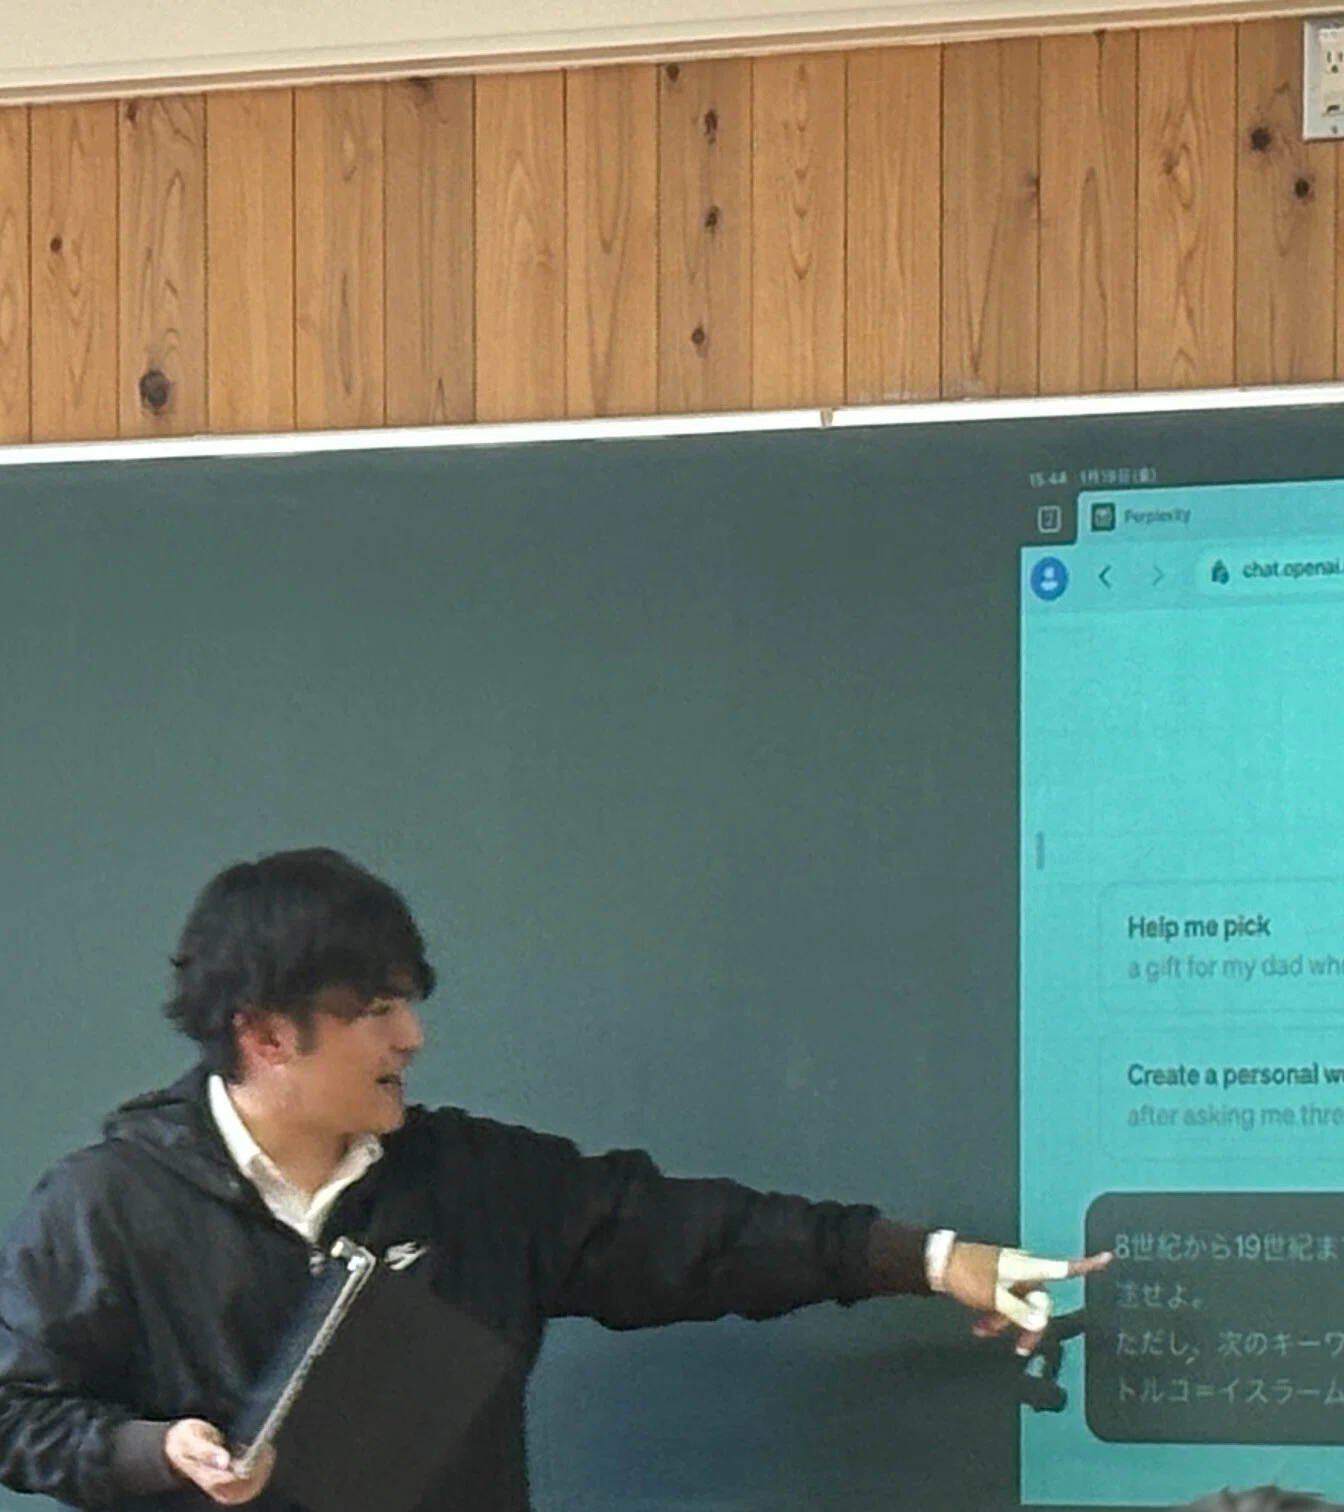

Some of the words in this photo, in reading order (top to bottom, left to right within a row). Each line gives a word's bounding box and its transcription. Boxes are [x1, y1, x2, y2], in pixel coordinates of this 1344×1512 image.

[1128, 914, 1179, 942] Help
[1184, 918, 1218, 938] me
[1223, 914, 1271, 942] pick
[1128, 962, 1140, 979] a
[1146, 954, 1182, 983] gift
[1186, 953, 1217, 979] for
[1223, 957, 1255, 983] my
[1262, 951, 1303, 978] dad
[1127, 1063, 1200, 1088] Create
[1204, 1067, 1219, 1086] a
[1223, 1060, 1320, 1091] personal
[1127, 1103, 1179, 1127] after
[1184, 1102, 1255, 1131] asking
[1260, 1106, 1296, 1126] me
